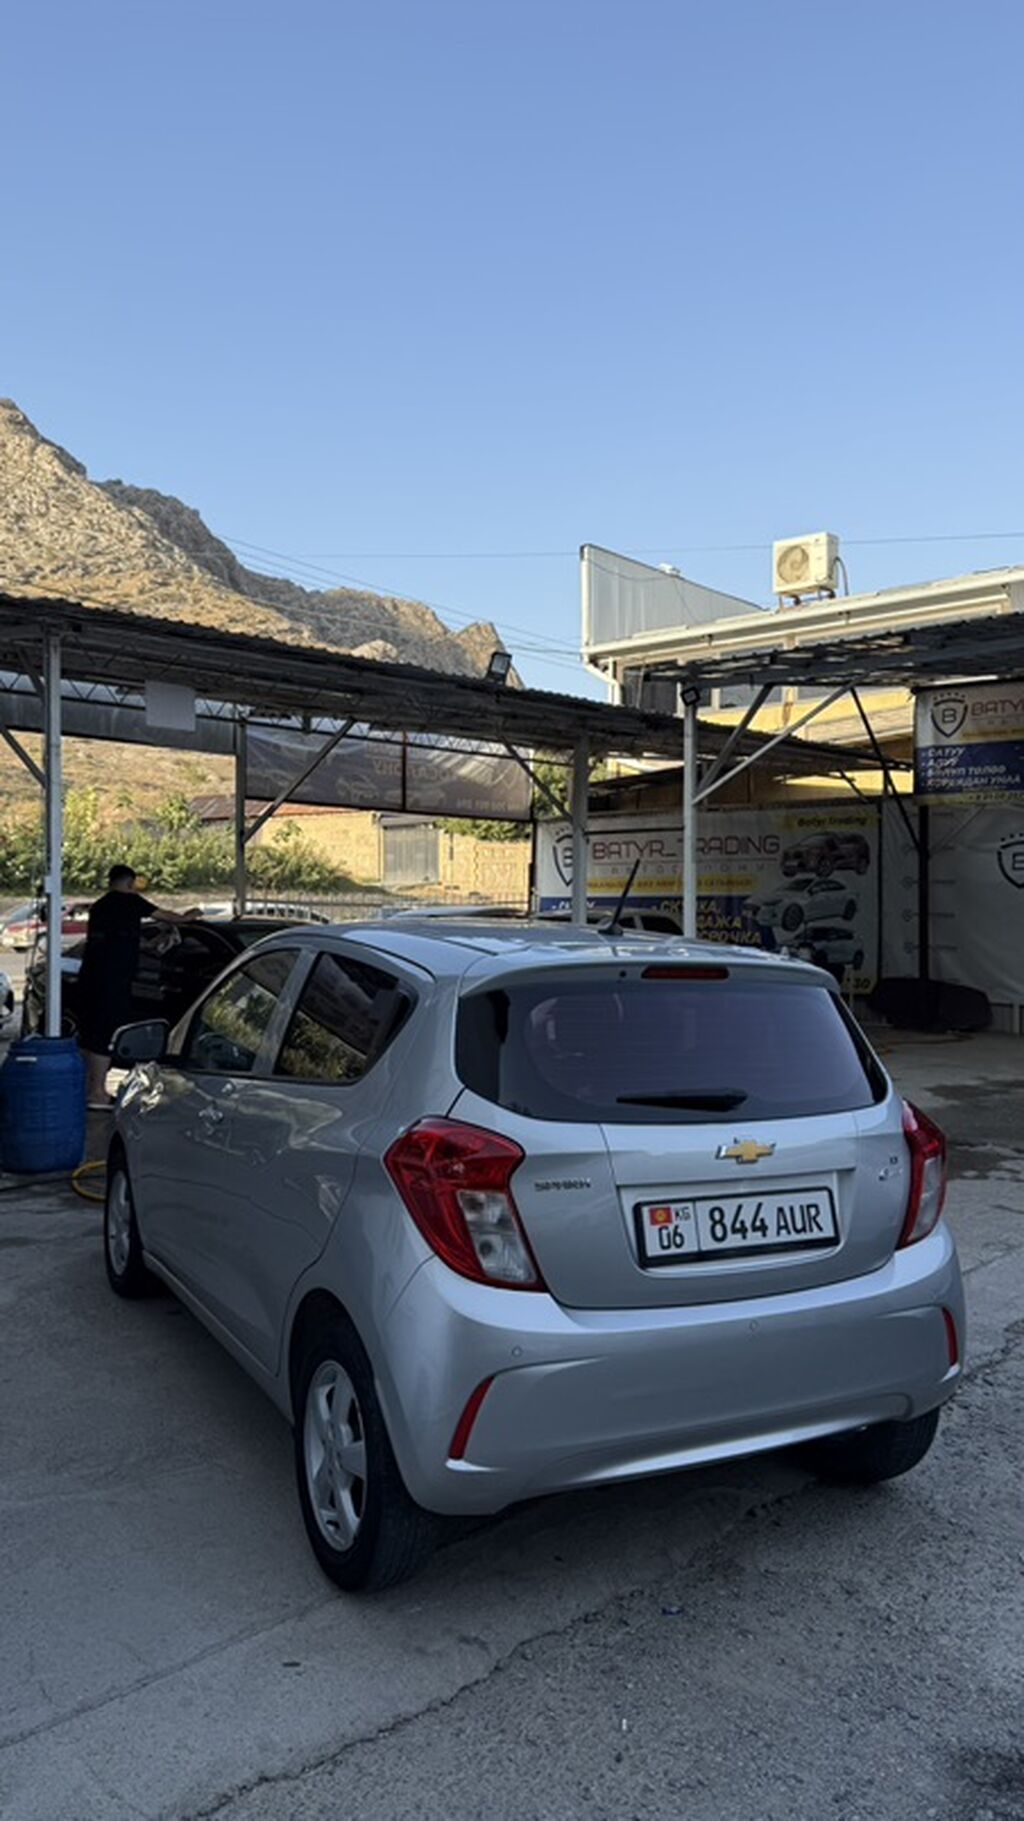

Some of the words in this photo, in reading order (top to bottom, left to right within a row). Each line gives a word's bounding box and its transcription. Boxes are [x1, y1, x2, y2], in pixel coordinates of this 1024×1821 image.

[971, 698, 1024, 717] BATY
[674, 1206, 691, 1222] KG
[709, 1202, 769, 1244] 844
[776, 1202, 823, 1237] AUR
[658, 1225, 685, 1251] 06
